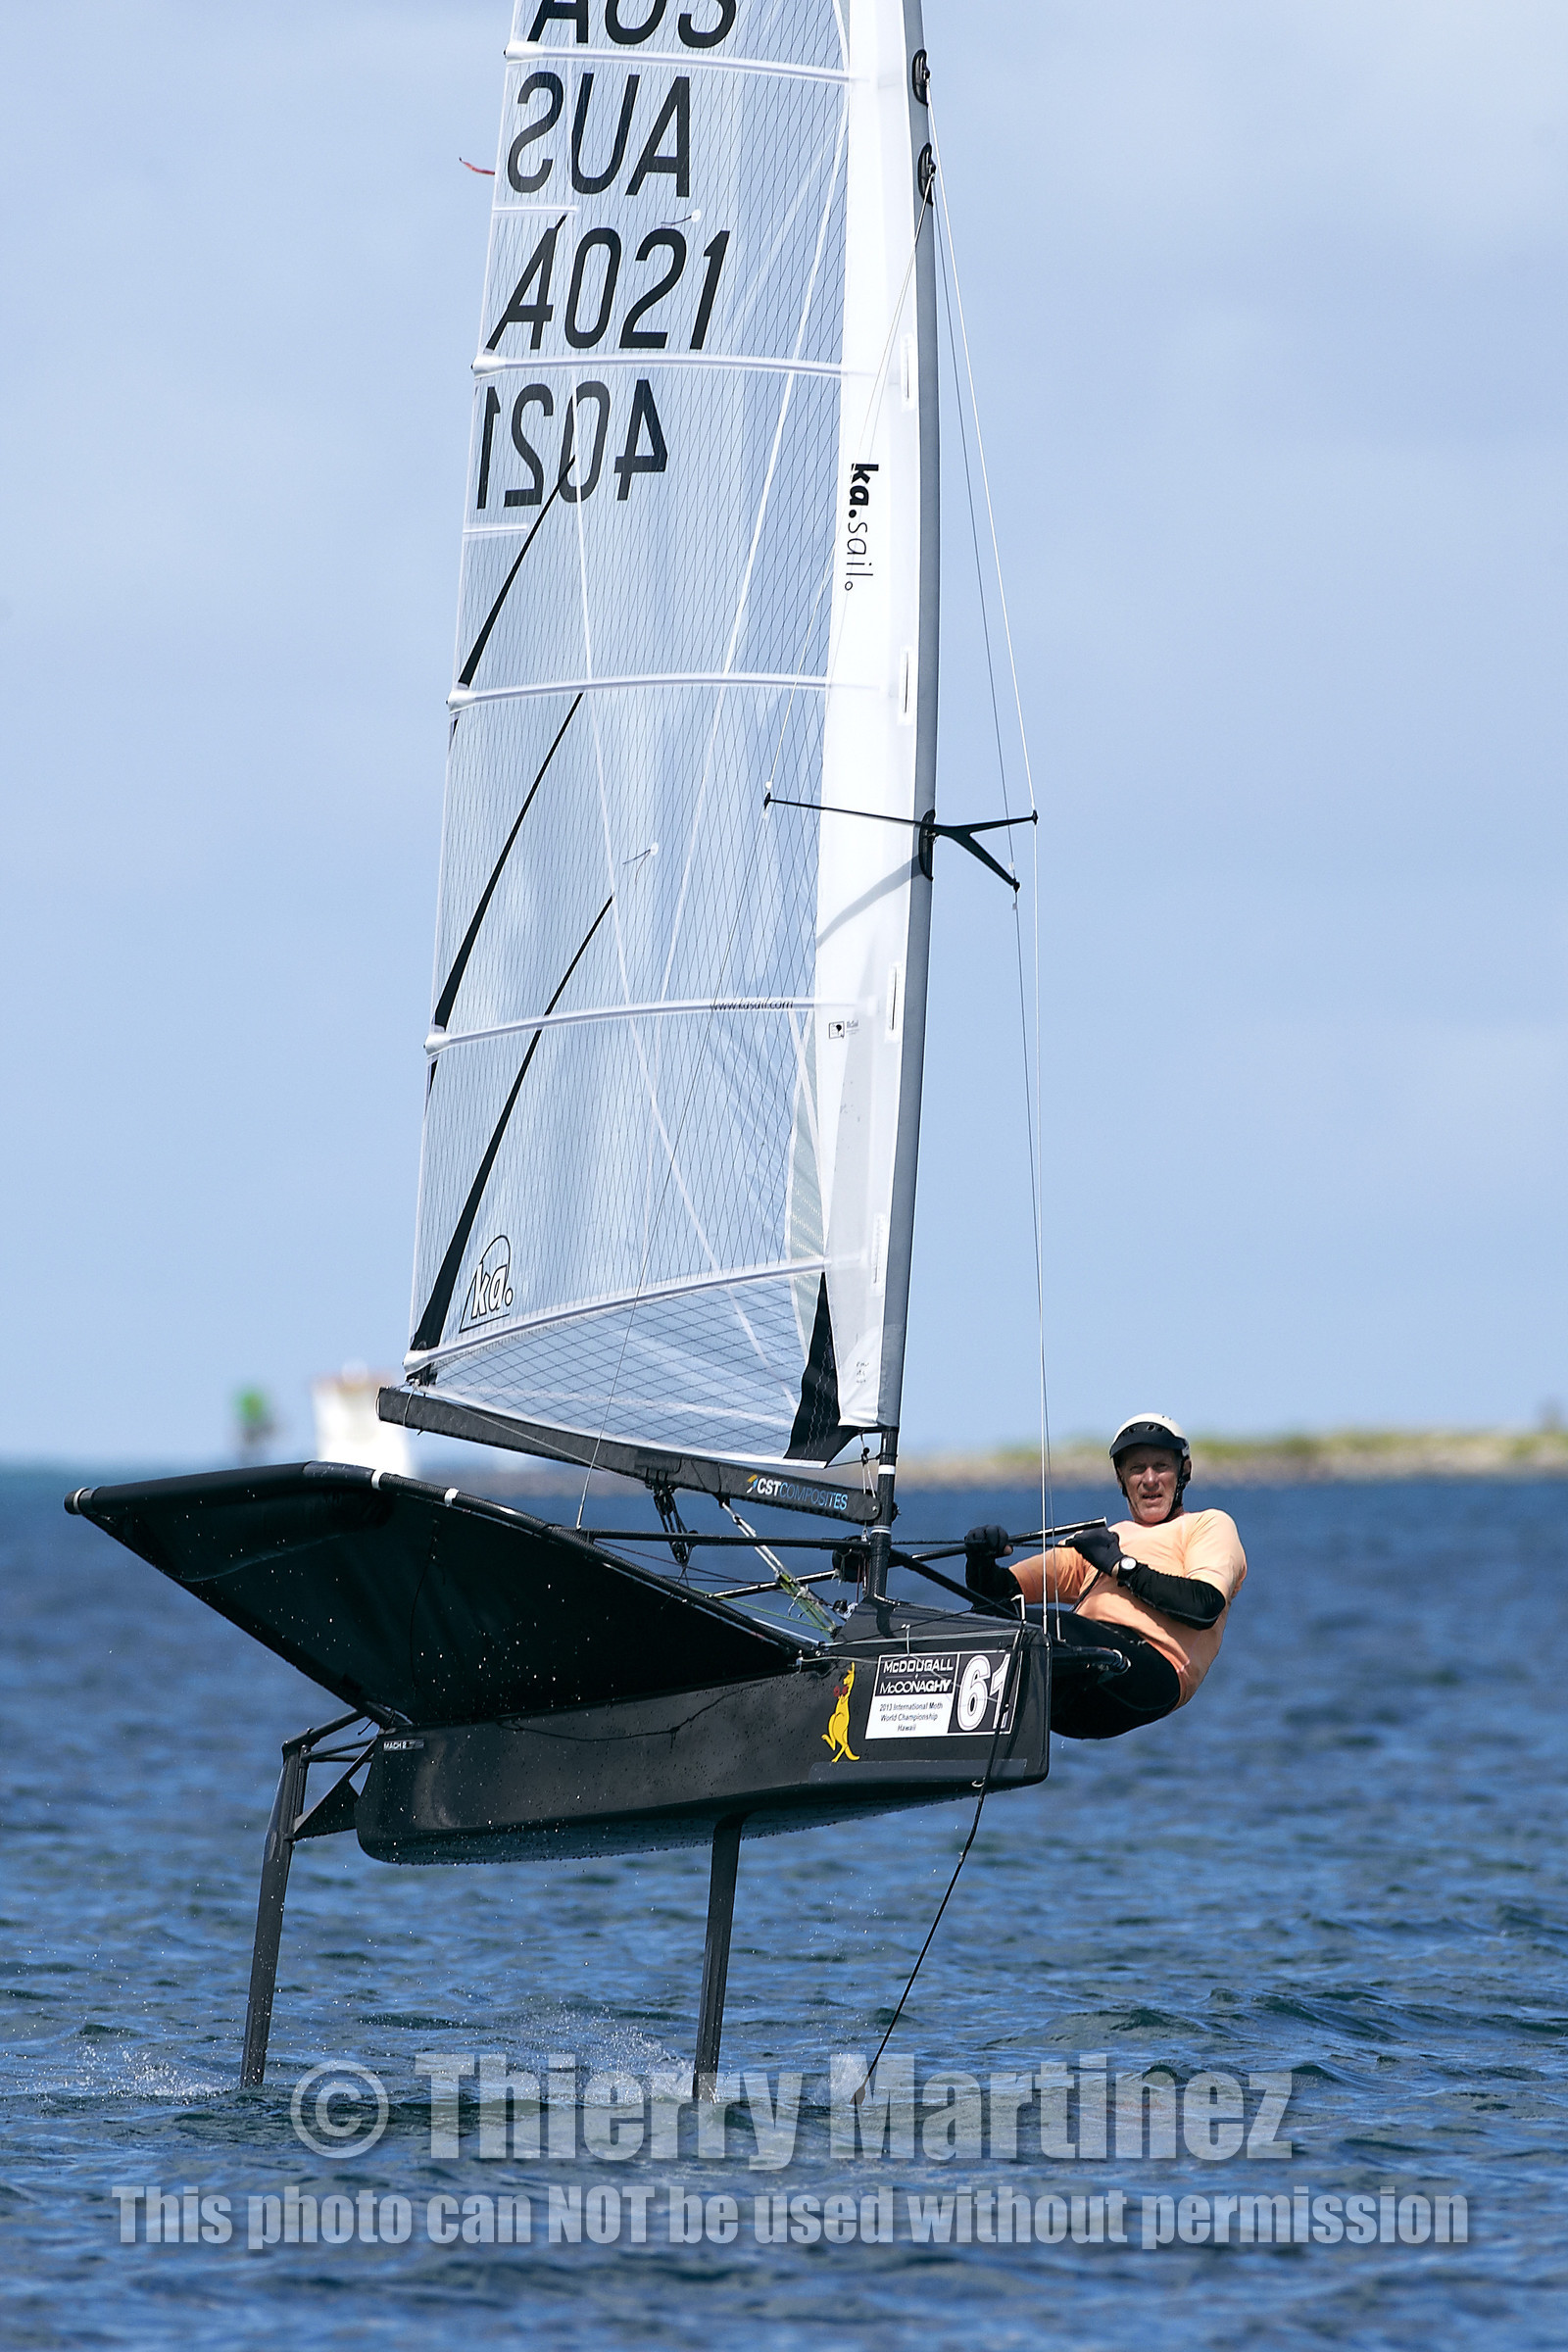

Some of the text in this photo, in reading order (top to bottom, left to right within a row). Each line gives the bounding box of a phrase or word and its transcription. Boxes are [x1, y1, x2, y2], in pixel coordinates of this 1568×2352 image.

[484, 225, 731, 351] 4021
[893, 1701, 928, 1711] International
[956, 1653, 1010, 1732] 61
[898, 1712, 939, 1722] Championship
